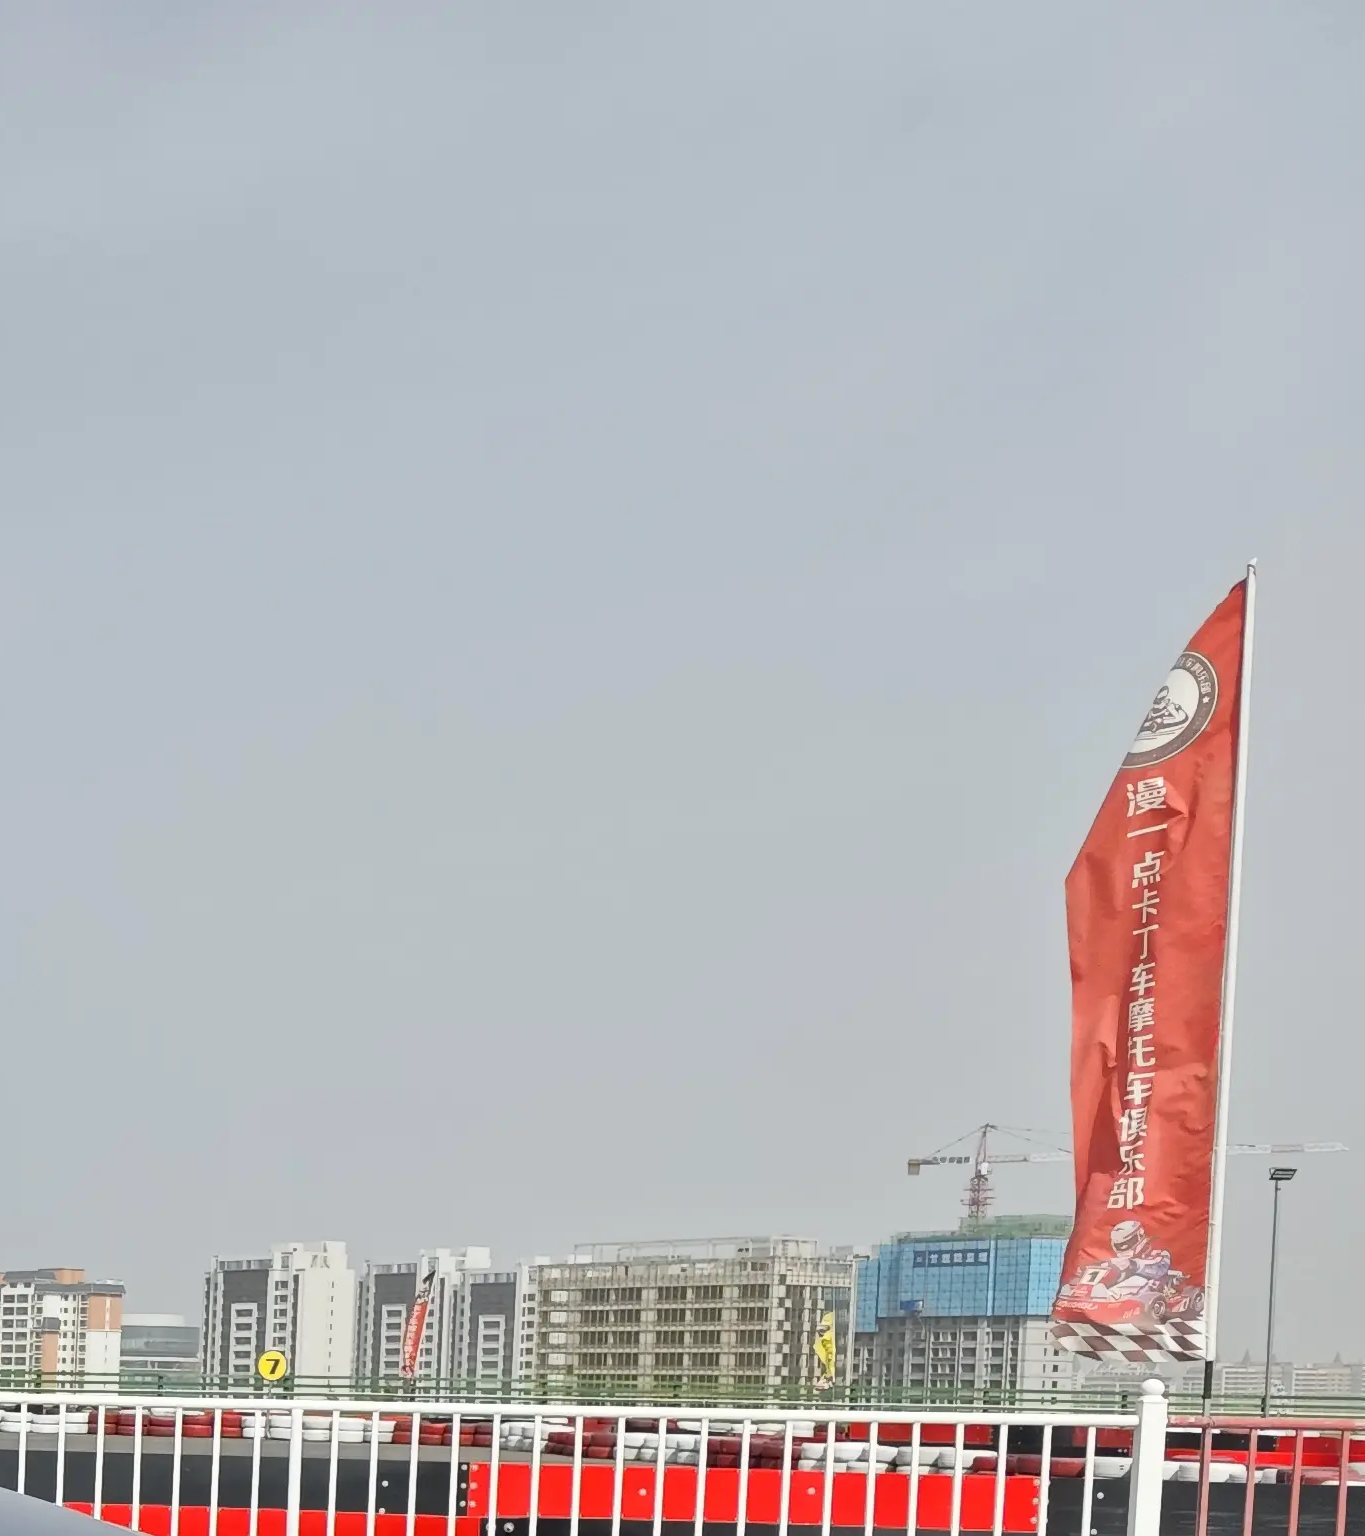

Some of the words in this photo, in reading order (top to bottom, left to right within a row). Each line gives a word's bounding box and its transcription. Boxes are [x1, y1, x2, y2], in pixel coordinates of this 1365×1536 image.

[1107, 775, 1169, 1210] 漫一点卡丁车摩托车俱乐部
[265, 1358, 281, 1375] 7
